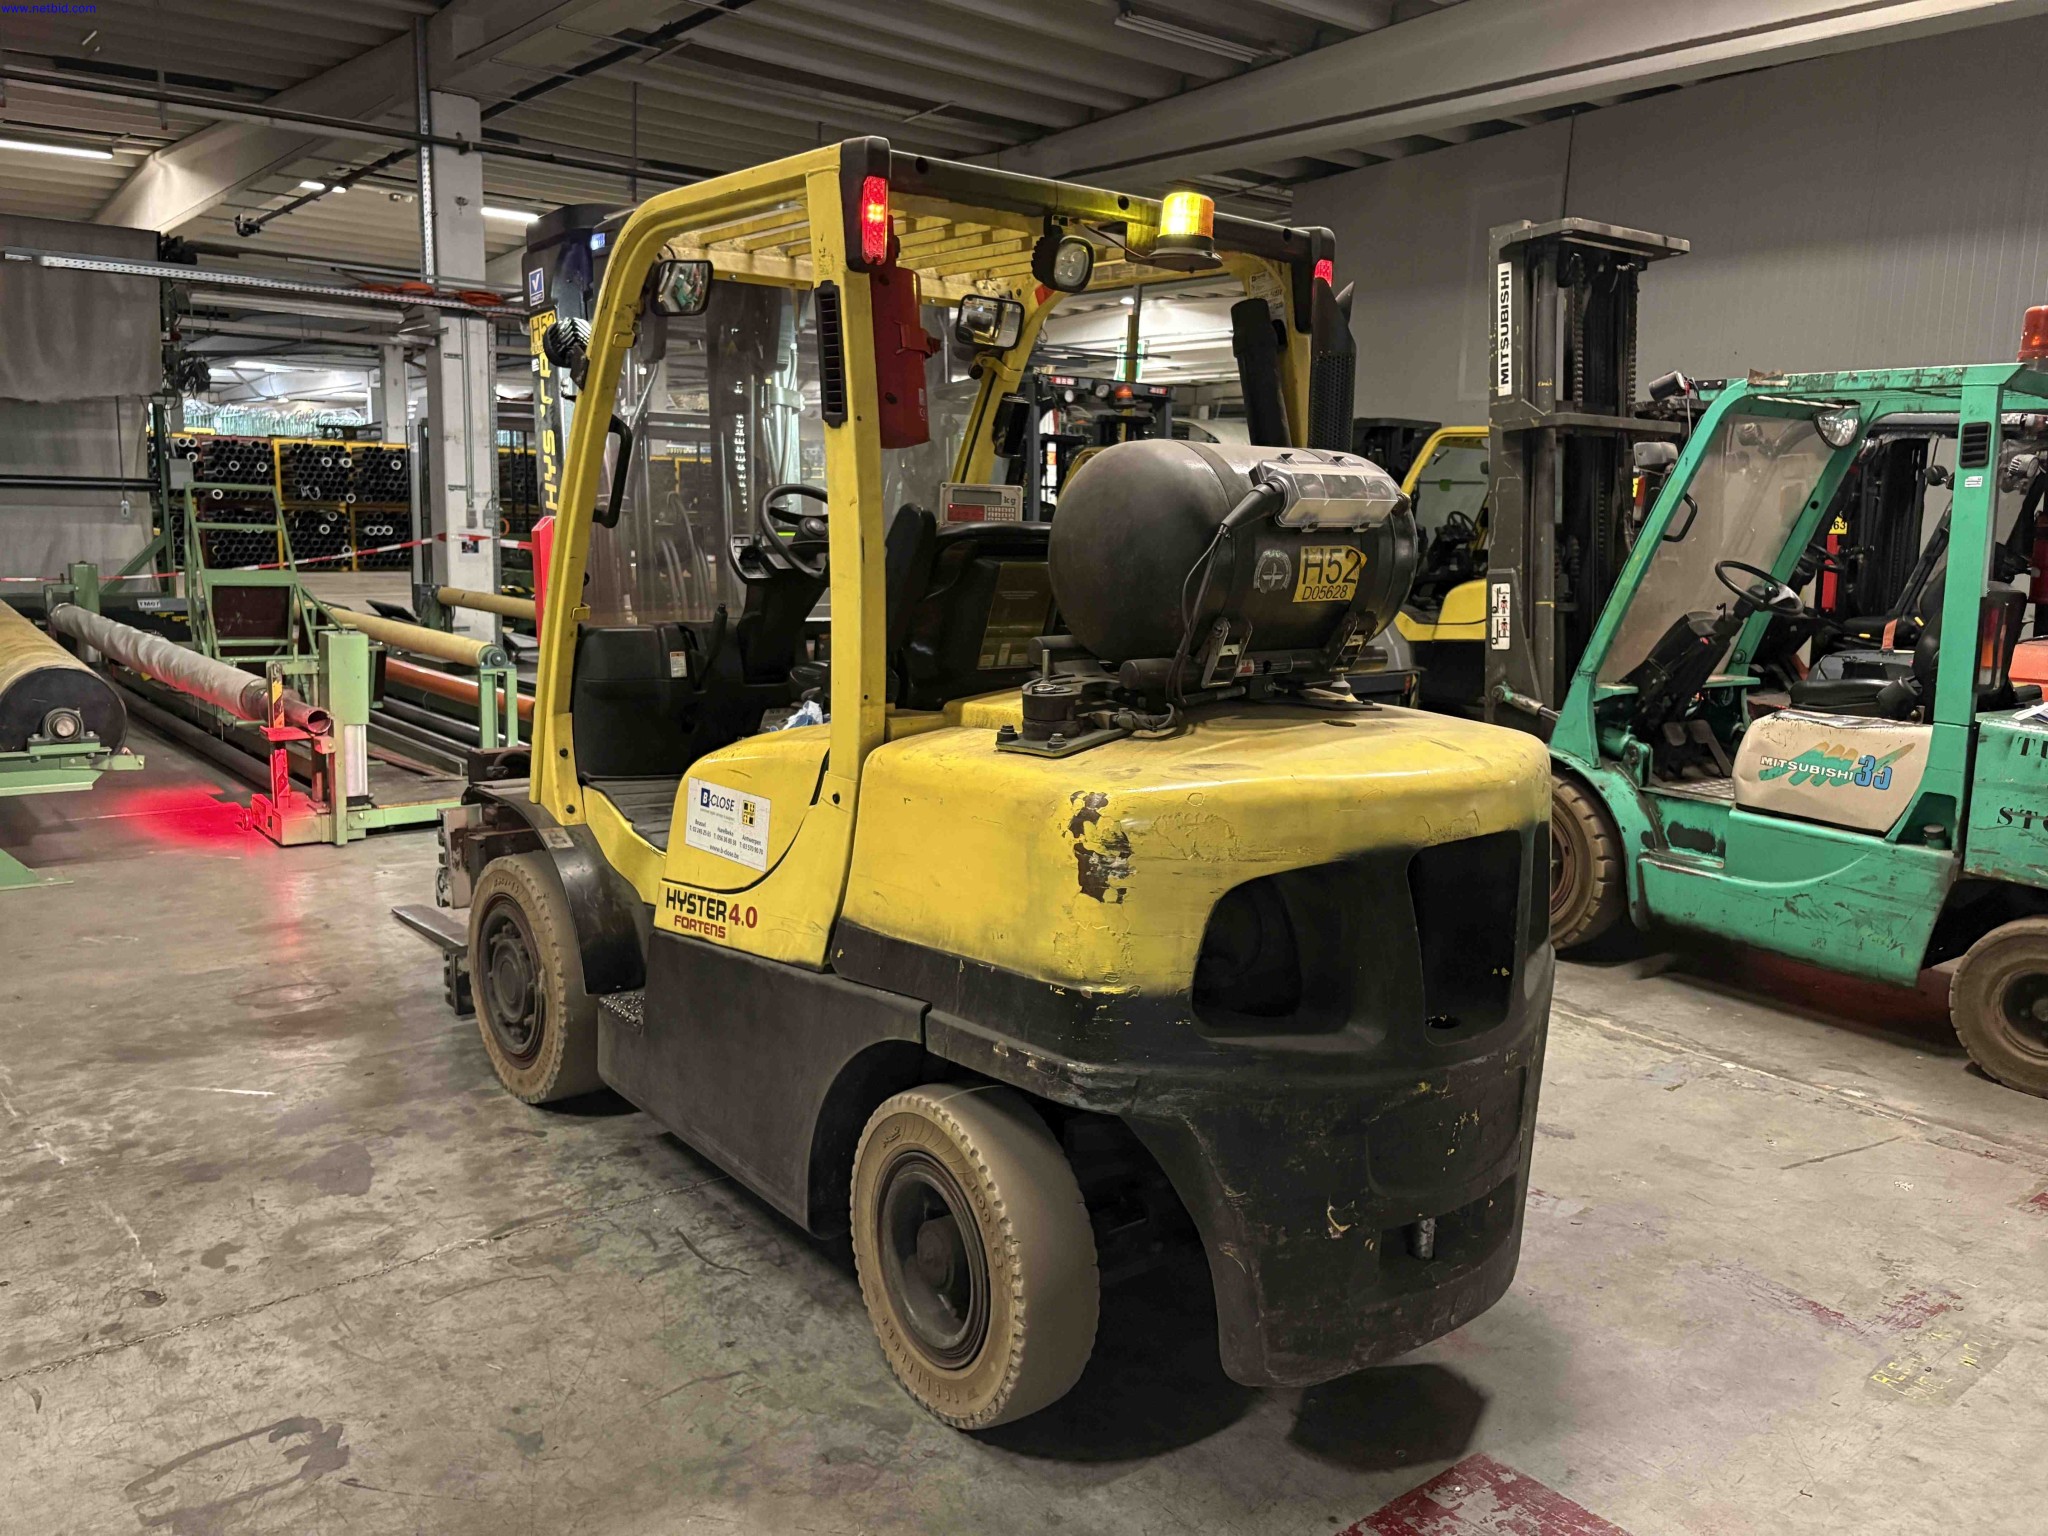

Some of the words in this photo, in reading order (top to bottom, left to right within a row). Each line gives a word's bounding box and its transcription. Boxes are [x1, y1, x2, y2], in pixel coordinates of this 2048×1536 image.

[1500, 270, 1510, 385] MITSUBISHI
[1003, 496, 1017, 506] kg
[1302, 548, 1362, 585] H52
[1301, 585, 1349, 601] D05628
[1760, 755, 1854, 781] MITSUBISHI
[666, 887, 727, 923] HYSTER
[728, 903, 758, 928] 4.0
[674, 915, 726, 939] FORTENS
